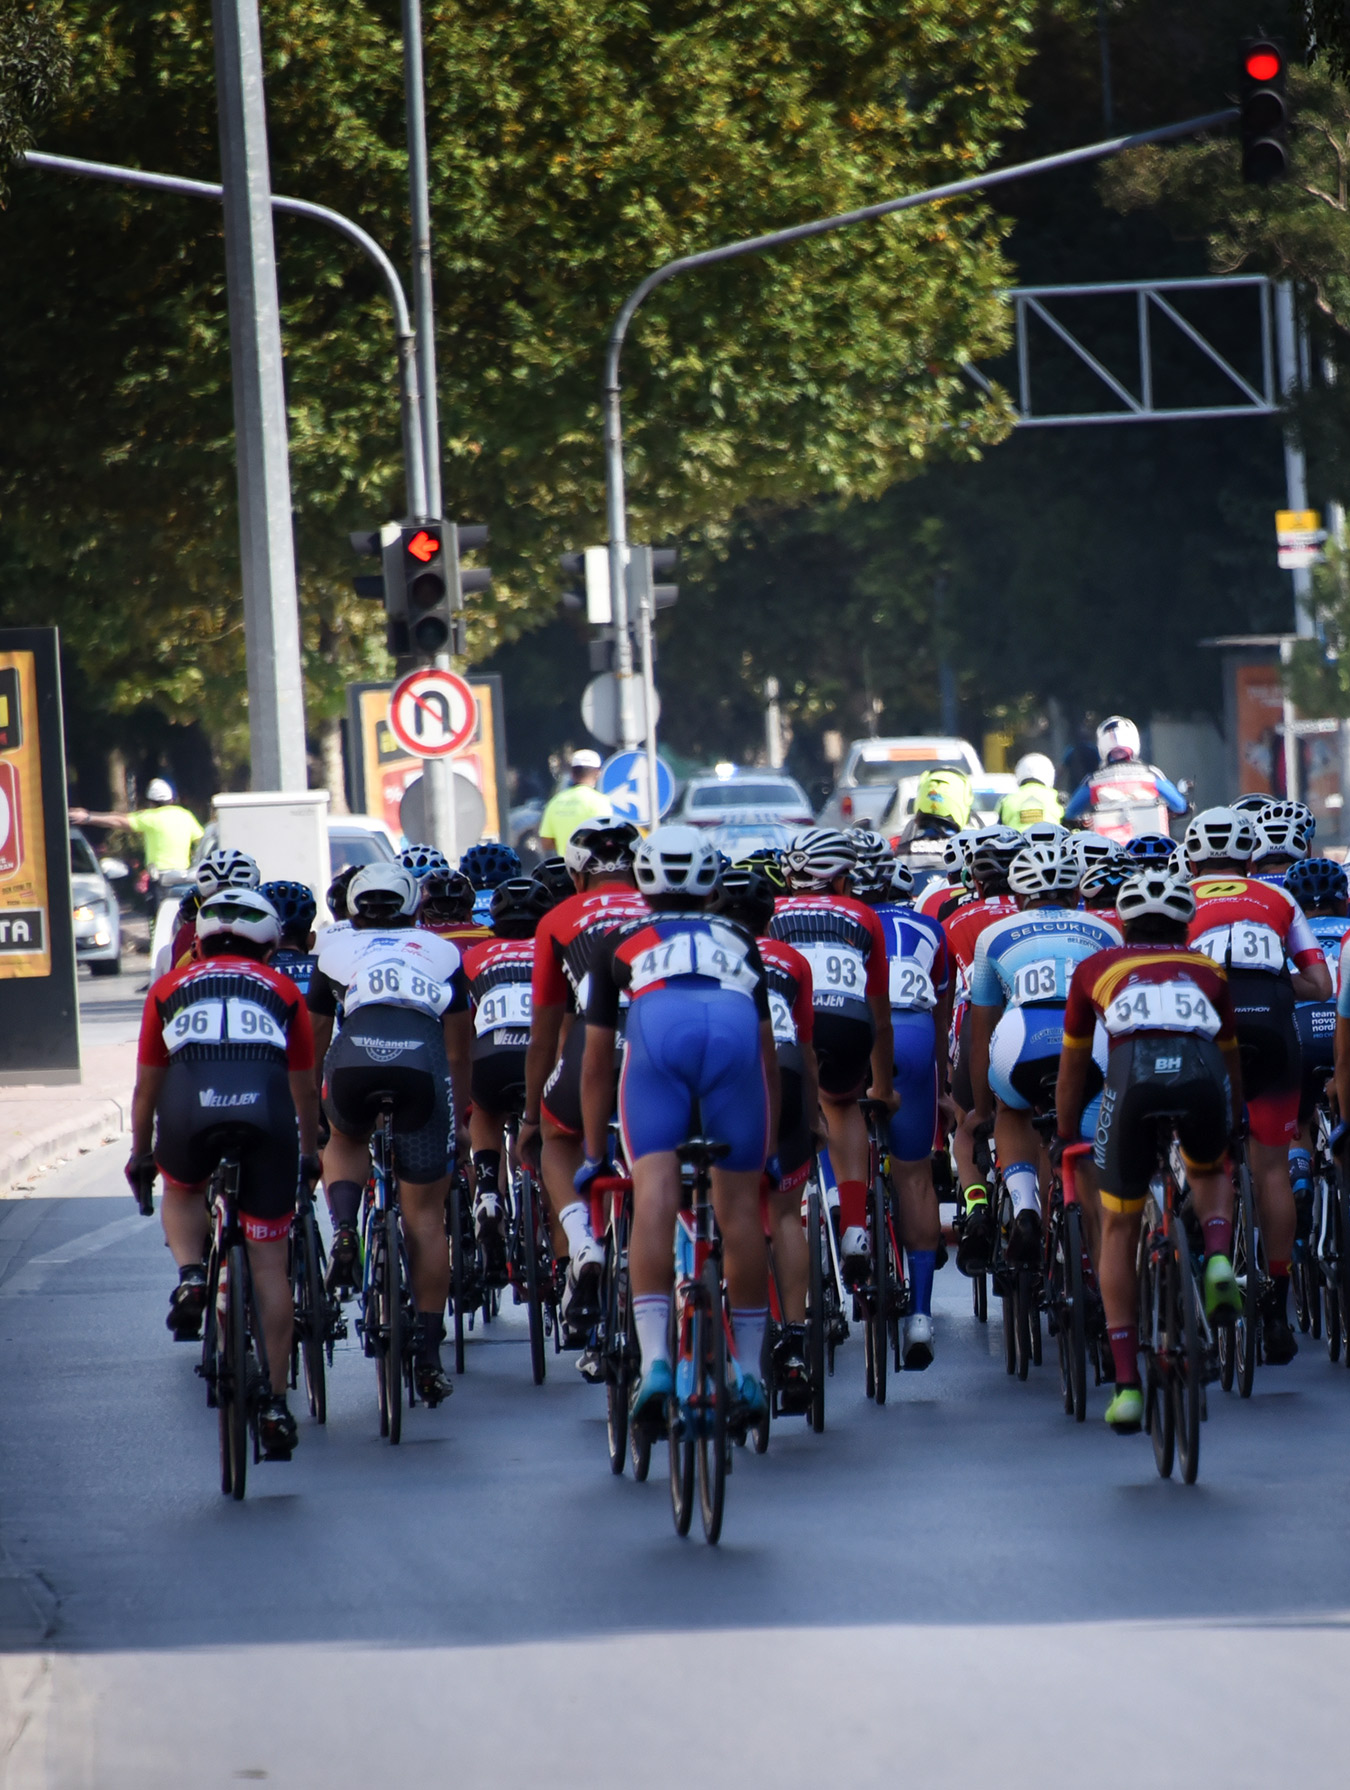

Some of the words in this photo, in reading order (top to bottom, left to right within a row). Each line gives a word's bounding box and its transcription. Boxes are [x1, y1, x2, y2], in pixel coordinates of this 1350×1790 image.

[641, 943, 676, 975] 47
[1243, 931, 1270, 960] 31
[368, 967, 400, 995] 86
[411, 976, 442, 1004] 86
[826, 956, 857, 988] 93
[900, 970, 928, 1001] 22
[174, 1010, 209, 1037] 96
[240, 1009, 275, 1036] 96
[483, 994, 507, 1024] 91
[1115, 992, 1152, 1023] 54
[1175, 993, 1211, 1024] 54
[362, 1037, 410, 1048] Vulcanet
[1154, 1056, 1183, 1071] BH
[199, 1088, 258, 1108] VELLAJEN
[1094, 1088, 1118, 1170] MIOGEE
